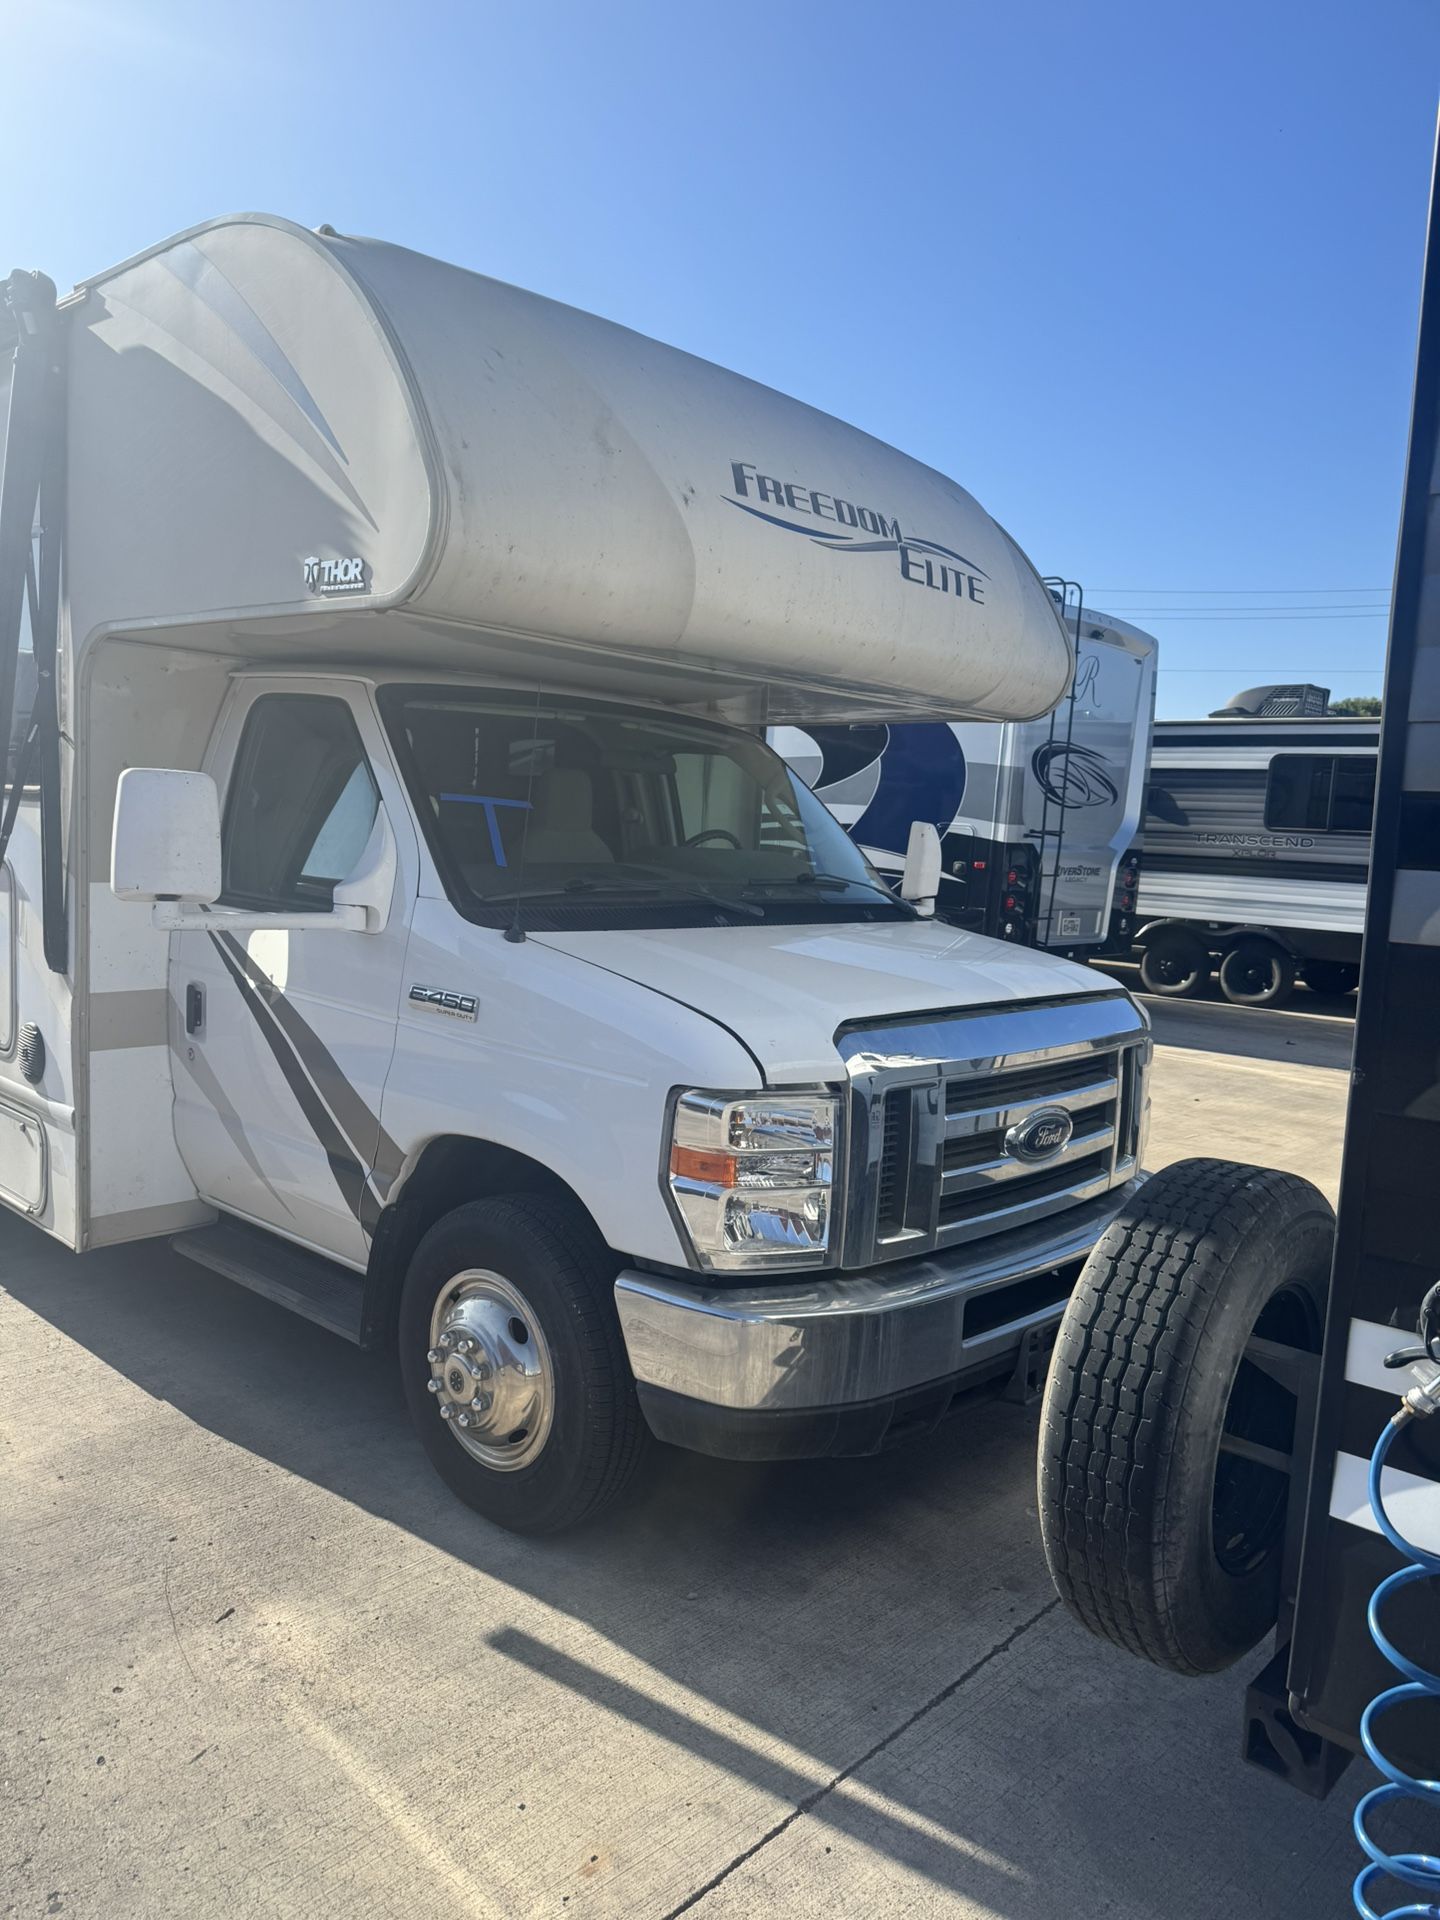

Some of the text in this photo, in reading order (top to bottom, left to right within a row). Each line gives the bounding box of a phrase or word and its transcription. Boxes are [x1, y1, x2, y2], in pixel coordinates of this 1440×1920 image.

[730, 459, 902, 542] FREEDOM
[321, 558, 363, 582] THOR
[900, 545, 985, 605] ELITE
[1193, 833, 1314, 848] TRANSCEND
[1035, 1124, 1062, 1147] Ford
